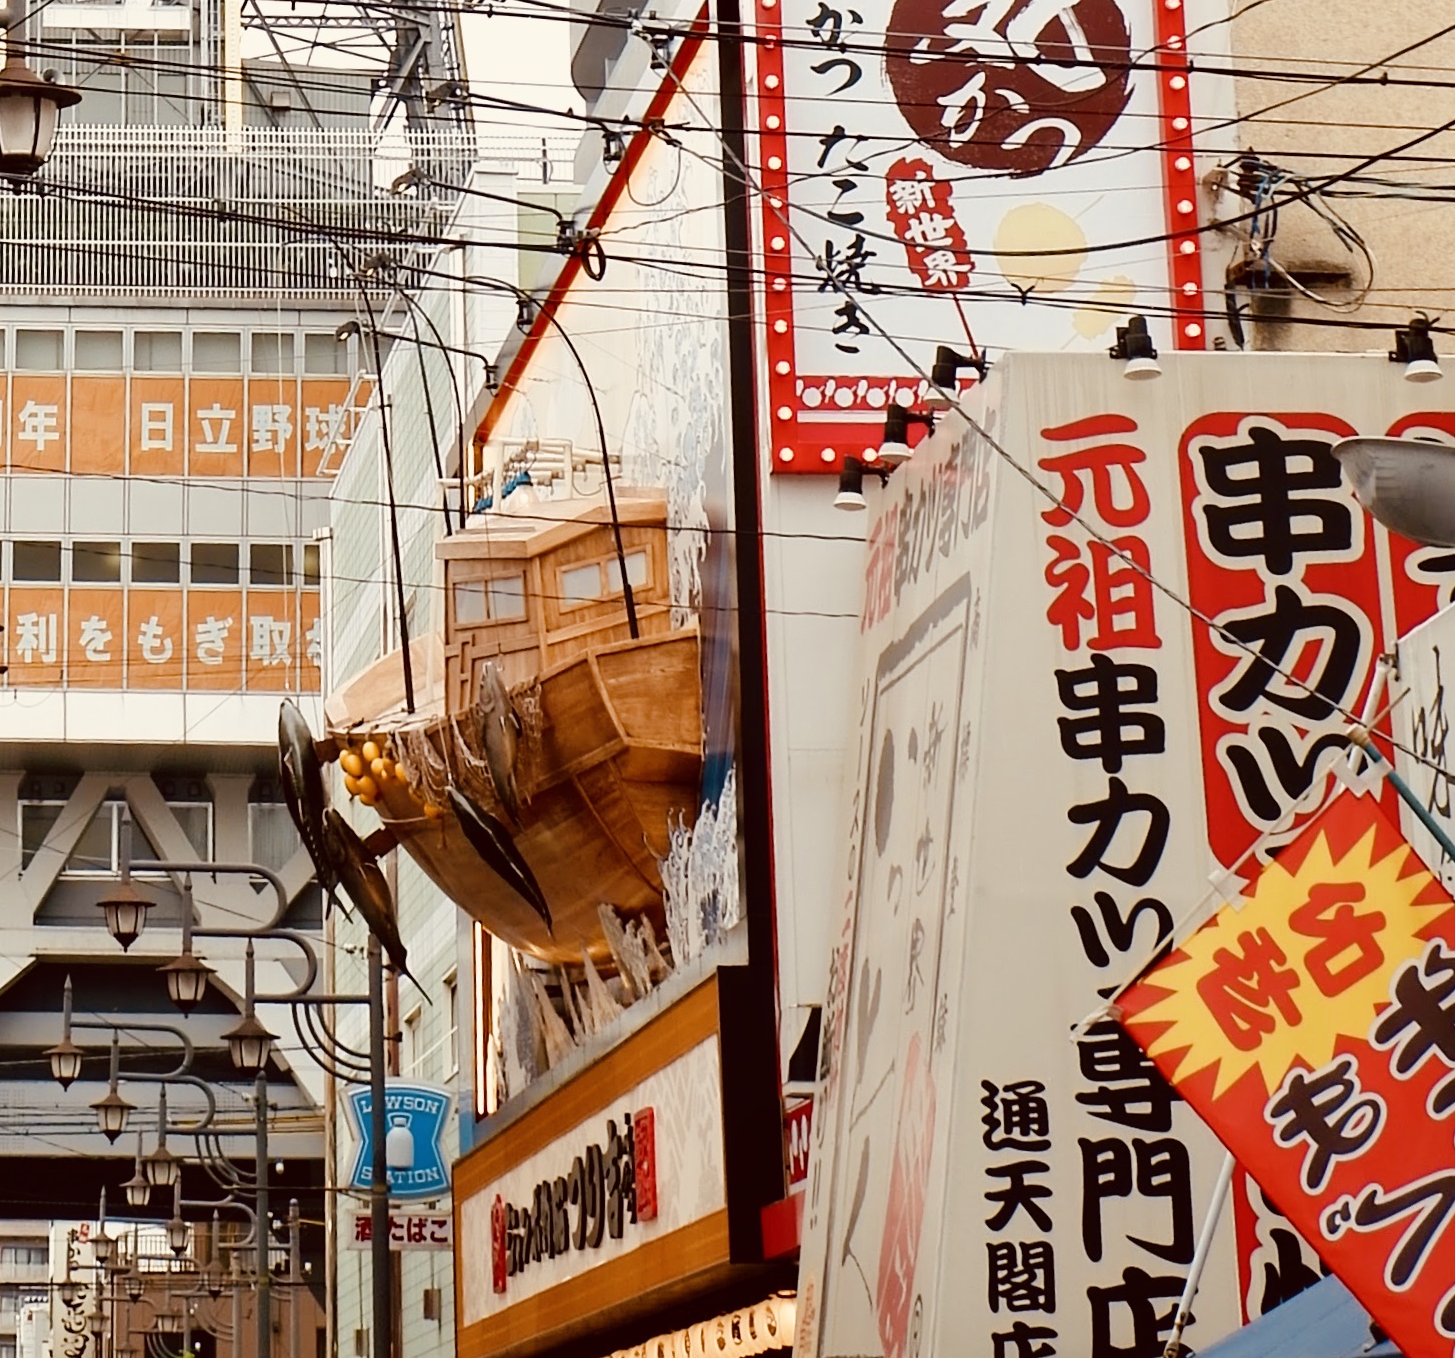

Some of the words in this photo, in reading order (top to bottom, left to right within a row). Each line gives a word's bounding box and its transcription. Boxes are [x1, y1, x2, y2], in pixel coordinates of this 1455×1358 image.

[815, 124, 880, 354] たこ焼き
[890, 171, 973, 287] 新世界
[360, 1096, 439, 1114] LWSON
[360, 1166, 439, 1184] SATION
